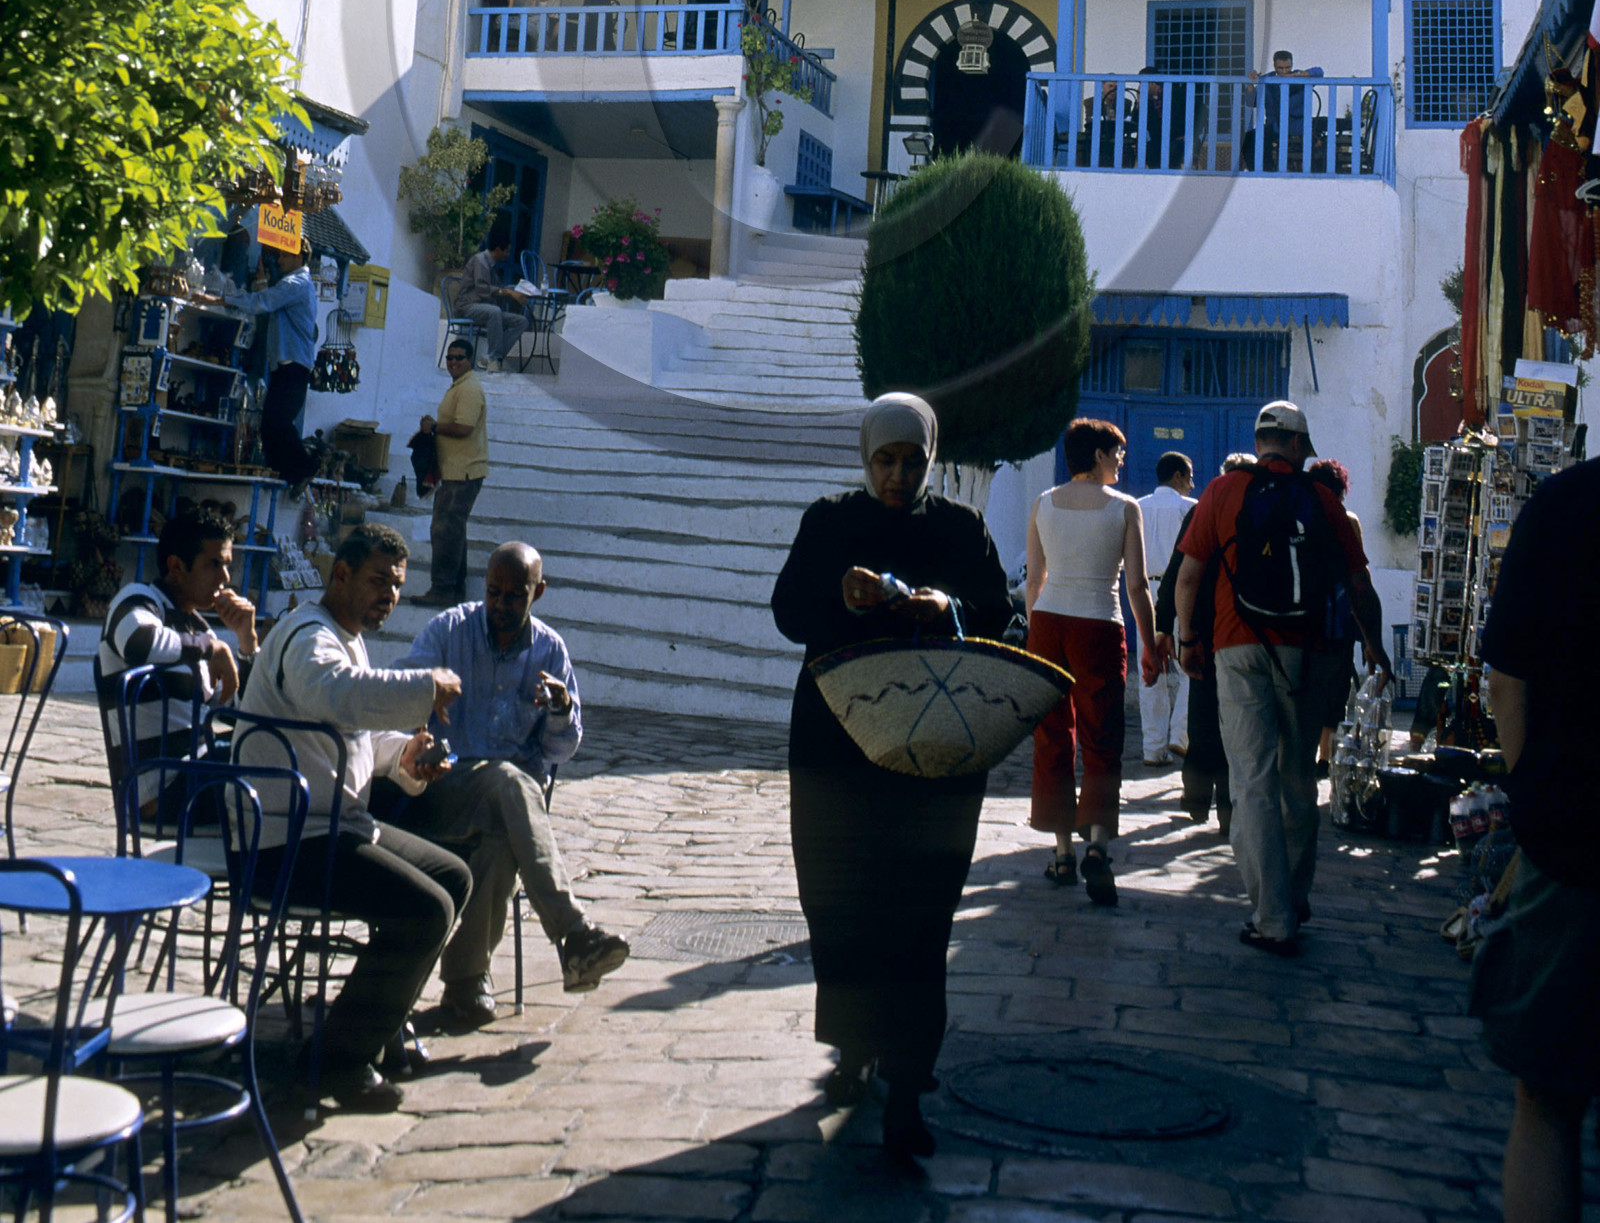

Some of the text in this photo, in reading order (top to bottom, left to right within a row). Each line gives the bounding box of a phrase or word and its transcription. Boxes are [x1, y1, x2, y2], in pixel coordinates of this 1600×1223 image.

[264, 209, 295, 235] Kodak
[280, 236, 295, 248] FILM
[1517, 378, 1545, 389] Kodak
[1506, 390, 1556, 408] ULTRA
